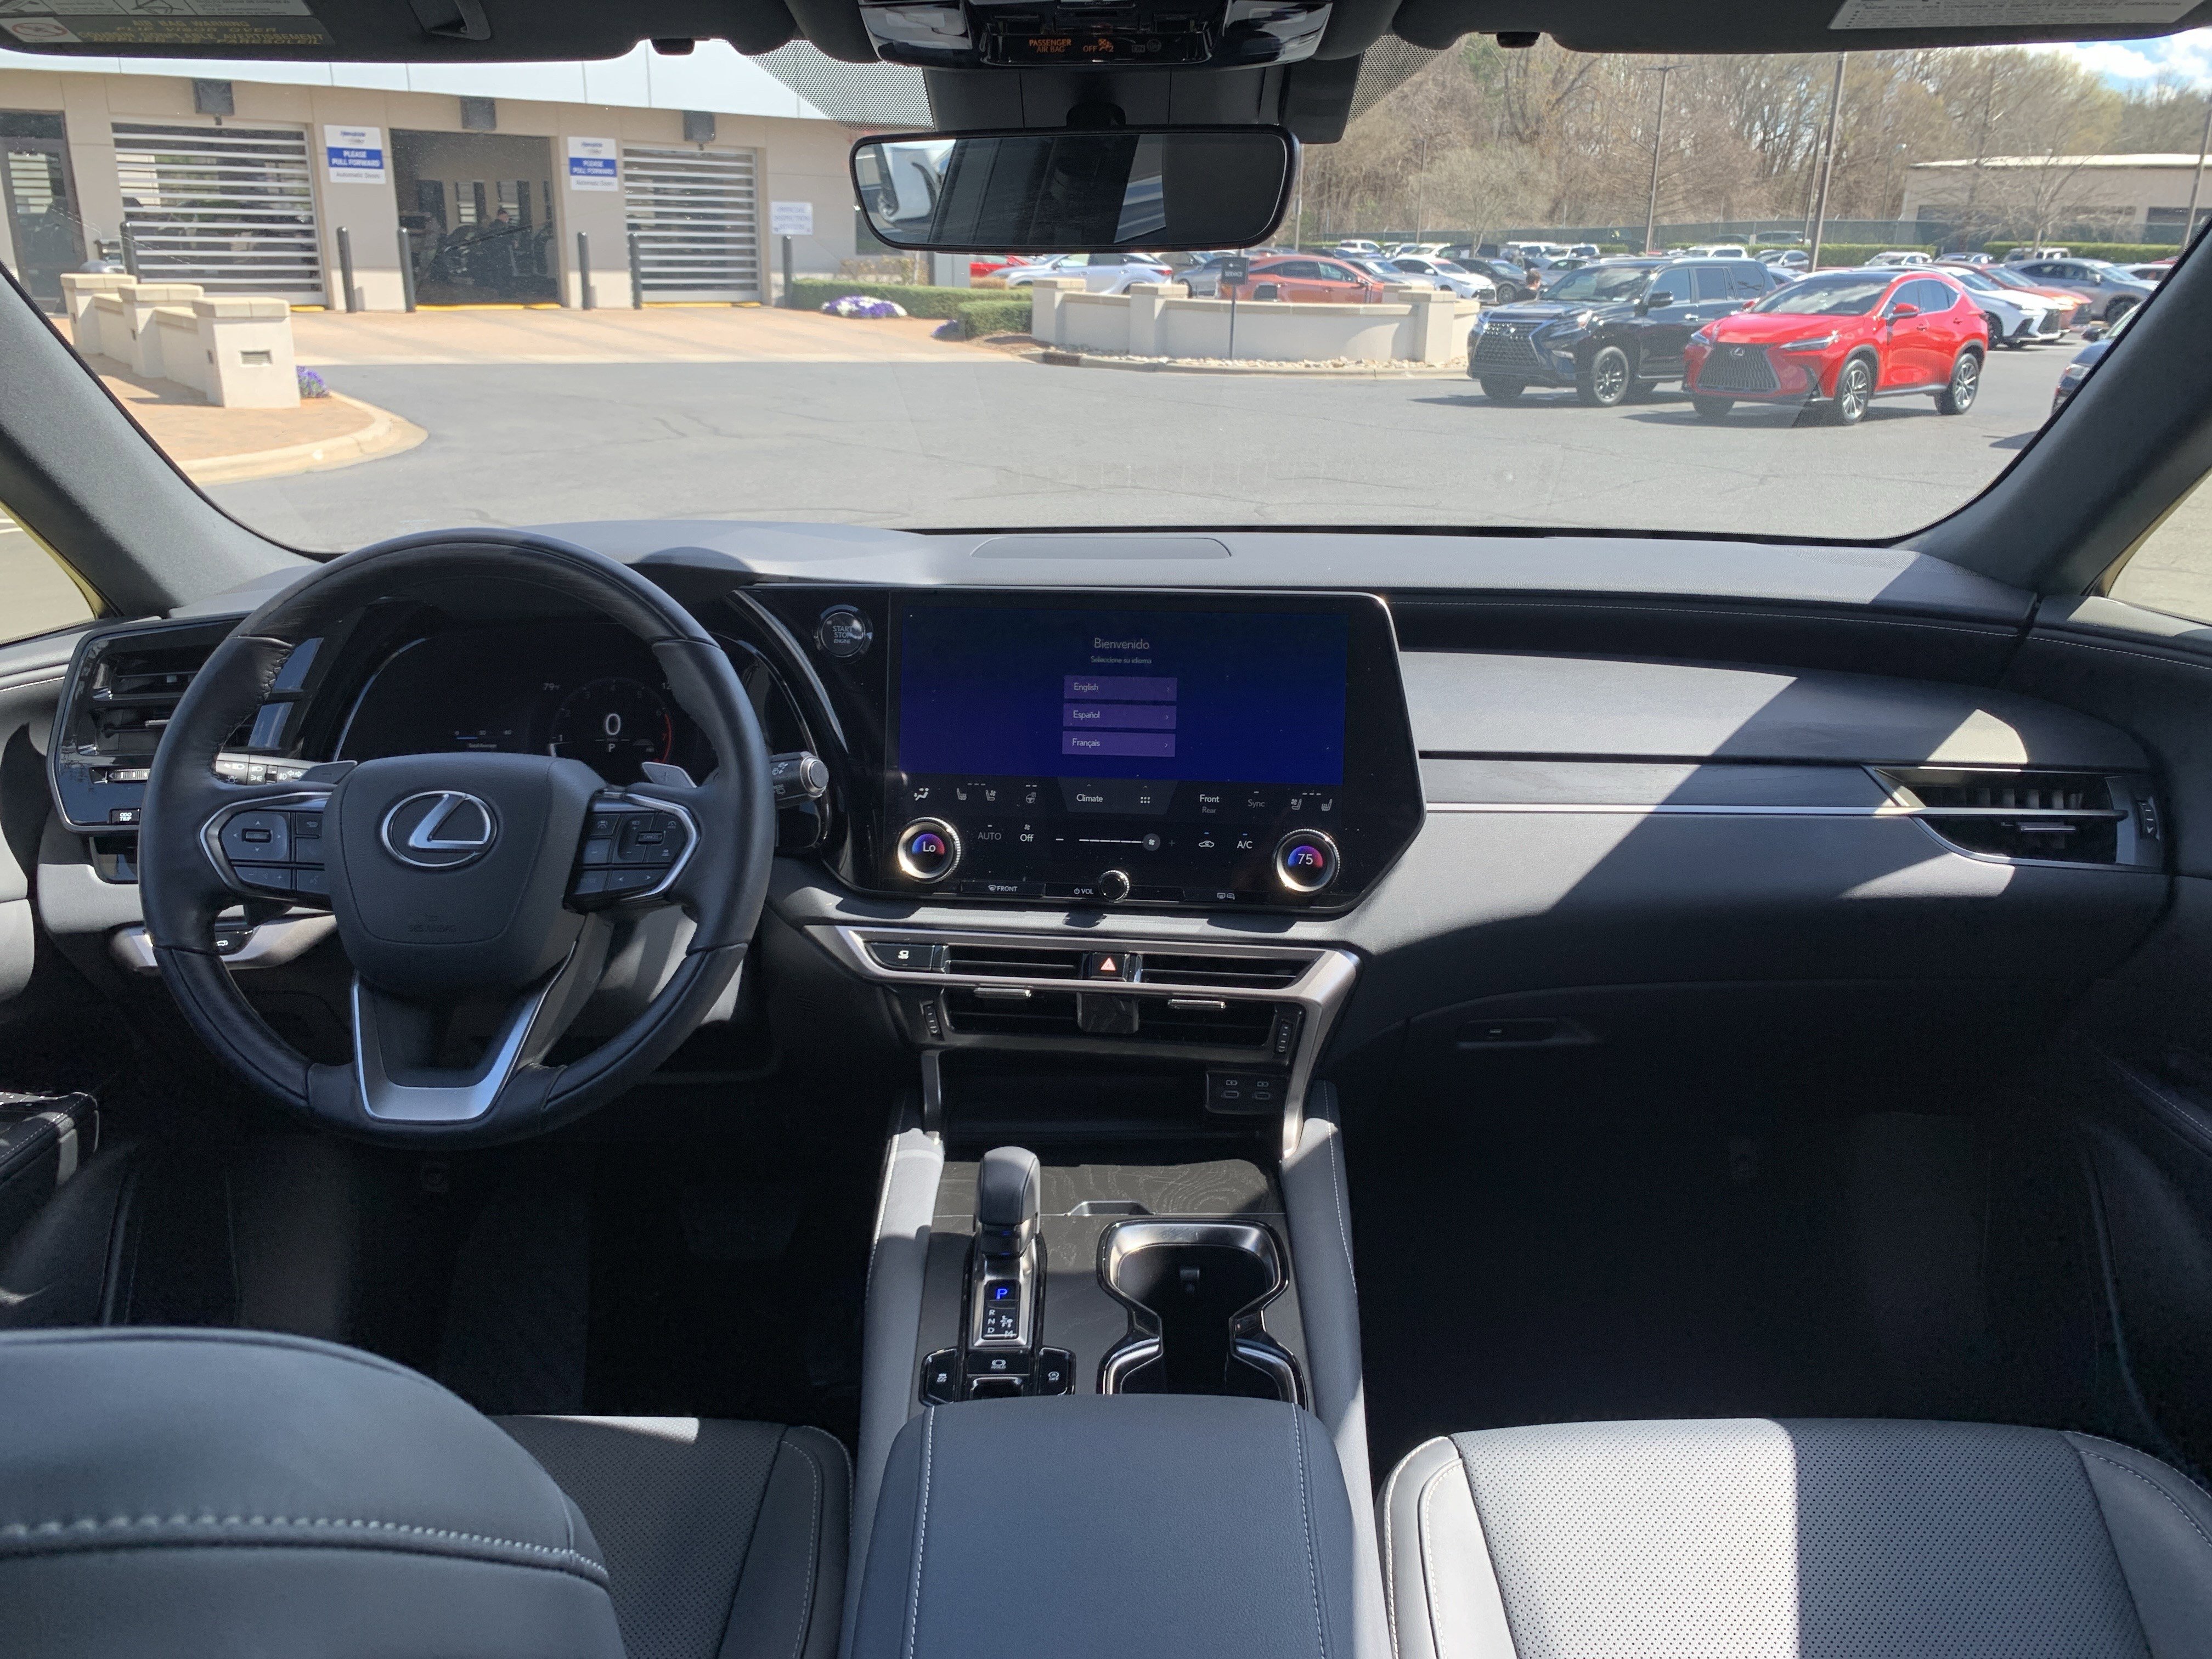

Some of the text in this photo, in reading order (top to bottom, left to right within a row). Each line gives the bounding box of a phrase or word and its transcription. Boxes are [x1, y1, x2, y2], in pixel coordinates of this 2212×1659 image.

[1094, 637, 1150, 649] Bienvenido
[1074, 682, 1099, 692] English
[1073, 710, 1100, 720] Español
[605, 713, 621, 736] 0
[608, 743, 616, 752] P
[1072, 737, 1101, 748] Français
[1076, 793, 1103, 803] Climate
[1199, 794, 1220, 803] Front
[1248, 799, 1265, 809] Sync
[978, 832, 1002, 840] AUTO
[1020, 833, 1035, 842] Off
[923, 841, 936, 853] Lo
[1237, 840, 1253, 850] A/C
[1297, 853, 1314, 865] 75
[996, 1288, 1008, 1300] P
